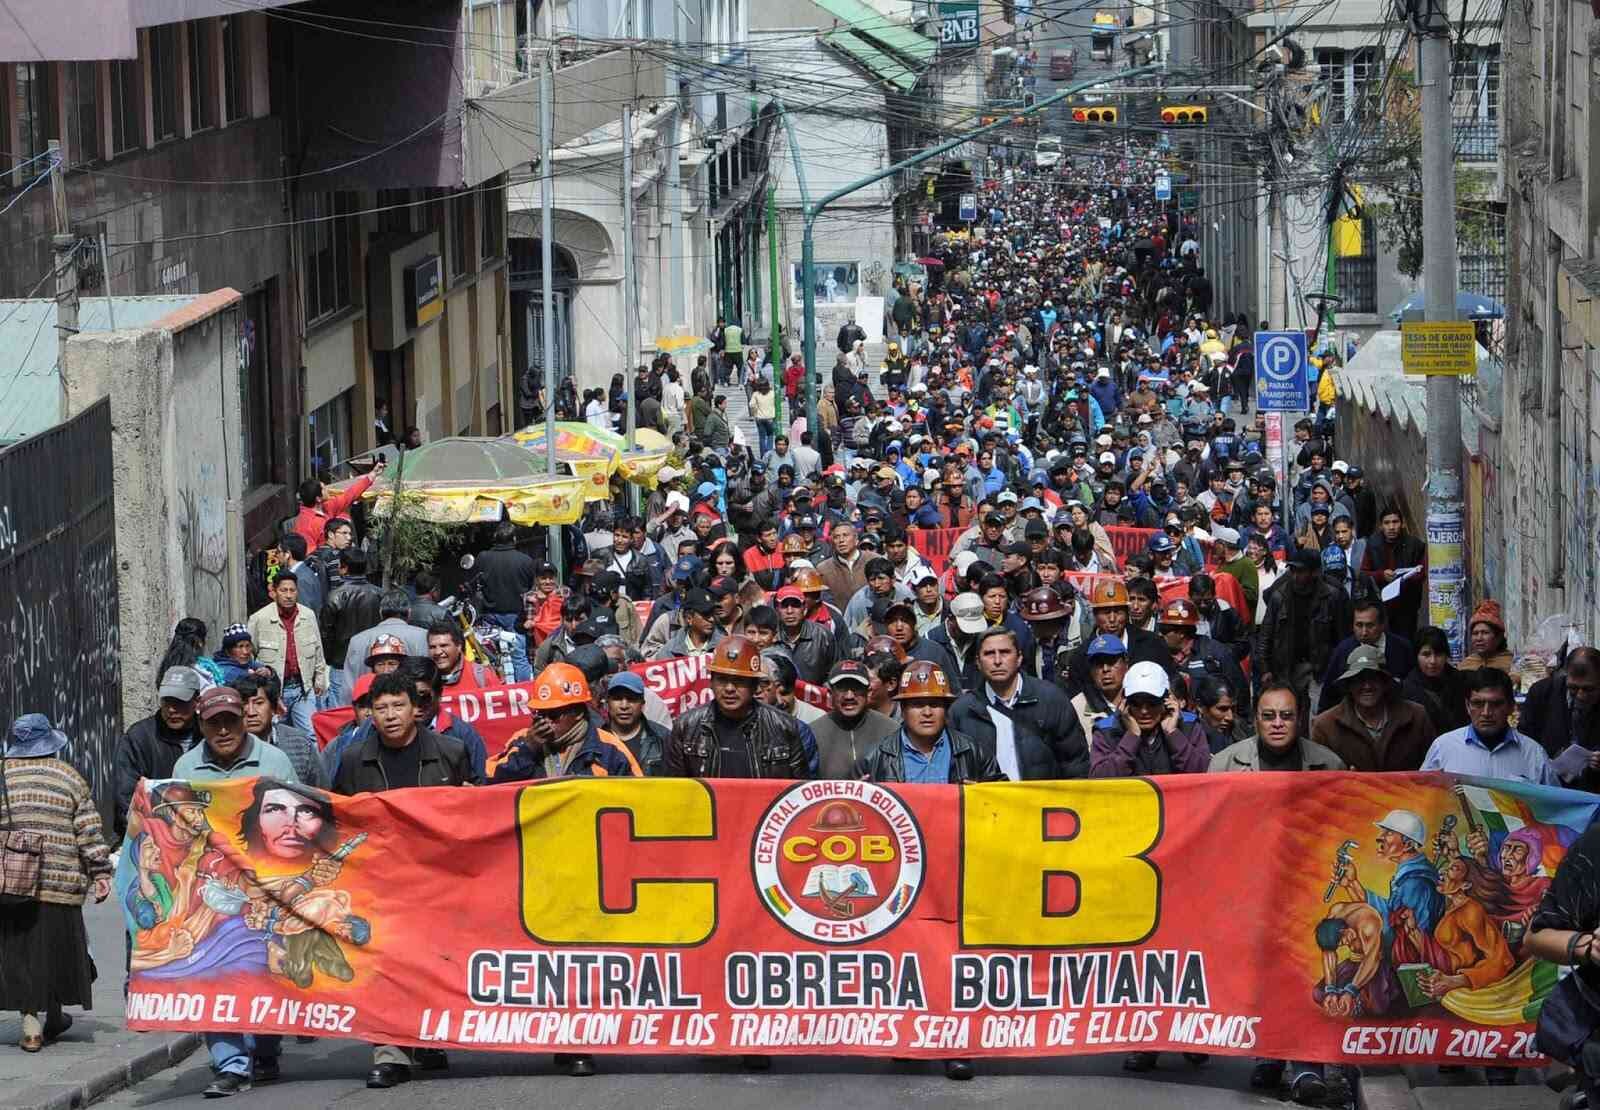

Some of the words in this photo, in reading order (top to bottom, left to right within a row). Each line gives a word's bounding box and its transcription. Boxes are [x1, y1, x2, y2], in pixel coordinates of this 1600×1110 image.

[943, 19, 977, 42] BNB
[1274, 345, 1289, 371] P
[757, 800, 800, 864] CENTRAL
[802, 782, 865, 801] OBRERA
[870, 789, 920, 864] BOLIVIANA
[782, 835, 896, 863] COB
[813, 921, 868, 938] CEN
[466, 950, 702, 1009] CENTRAL
[724, 952, 928, 1010] OBRERA
[951, 950, 1211, 1011] BOLIVIANA
[212, 995, 240, 1023] EL
[249, 996, 357, 1033] 17-IV-1952
[419, 1010, 449, 1041] LA
[458, 1011, 622, 1045] EMANCIPACION
[629, 1014, 662, 1046] DE
[668, 1012, 718, 1047] LOS
[730, 1013, 903, 1048] TRABAJADORES
[909, 1014, 969, 1049] SERA
[980, 1013, 1036, 1048] OBRA
[1046, 1011, 1080, 1046] DE
[1086, 1010, 1163, 1044] ELLOS
[1170, 1011, 1261, 1049] MISMOS
[1341, 1022, 1439, 1056] GESTIÓN
[1445, 1030, 1545, 1060] 2012-20
